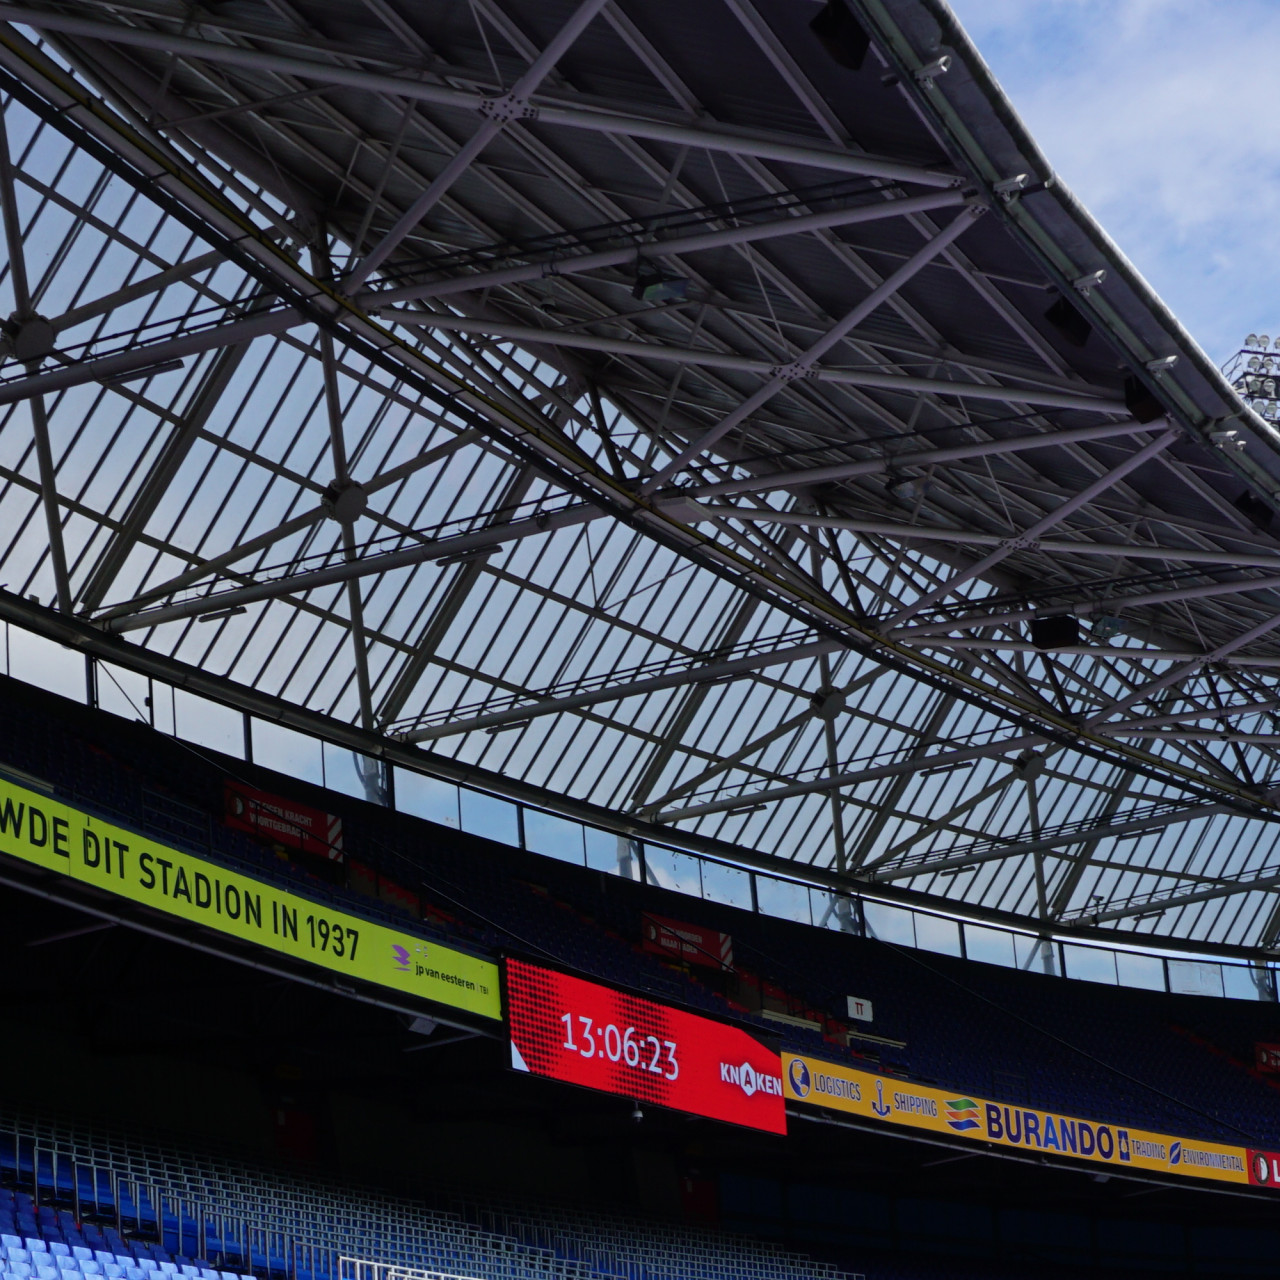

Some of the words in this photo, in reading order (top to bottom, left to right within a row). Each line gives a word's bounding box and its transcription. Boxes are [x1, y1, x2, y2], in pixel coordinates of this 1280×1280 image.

[83, 828, 129, 879] DIT
[140, 853, 262, 928] STADION
[273, 901, 297, 941] IN
[307, 915, 359, 960] 1937
[415, 961, 424, 976] jp
[425, 967, 440, 980] van
[441, 973, 475, 991] eesteren
[561, 1012, 679, 1081] 13:06:23
[720, 1061, 783, 1096] KNAKEN
[813, 1072, 862, 1102] LOGISTICS
[893, 1092, 938, 1117] SHIPPING
[985, 1103, 1114, 1160] BURANDO
[1131, 1138, 1167, 1160] TRADING
[1182, 1148, 1246, 1172] ENVIRONMENTAL
